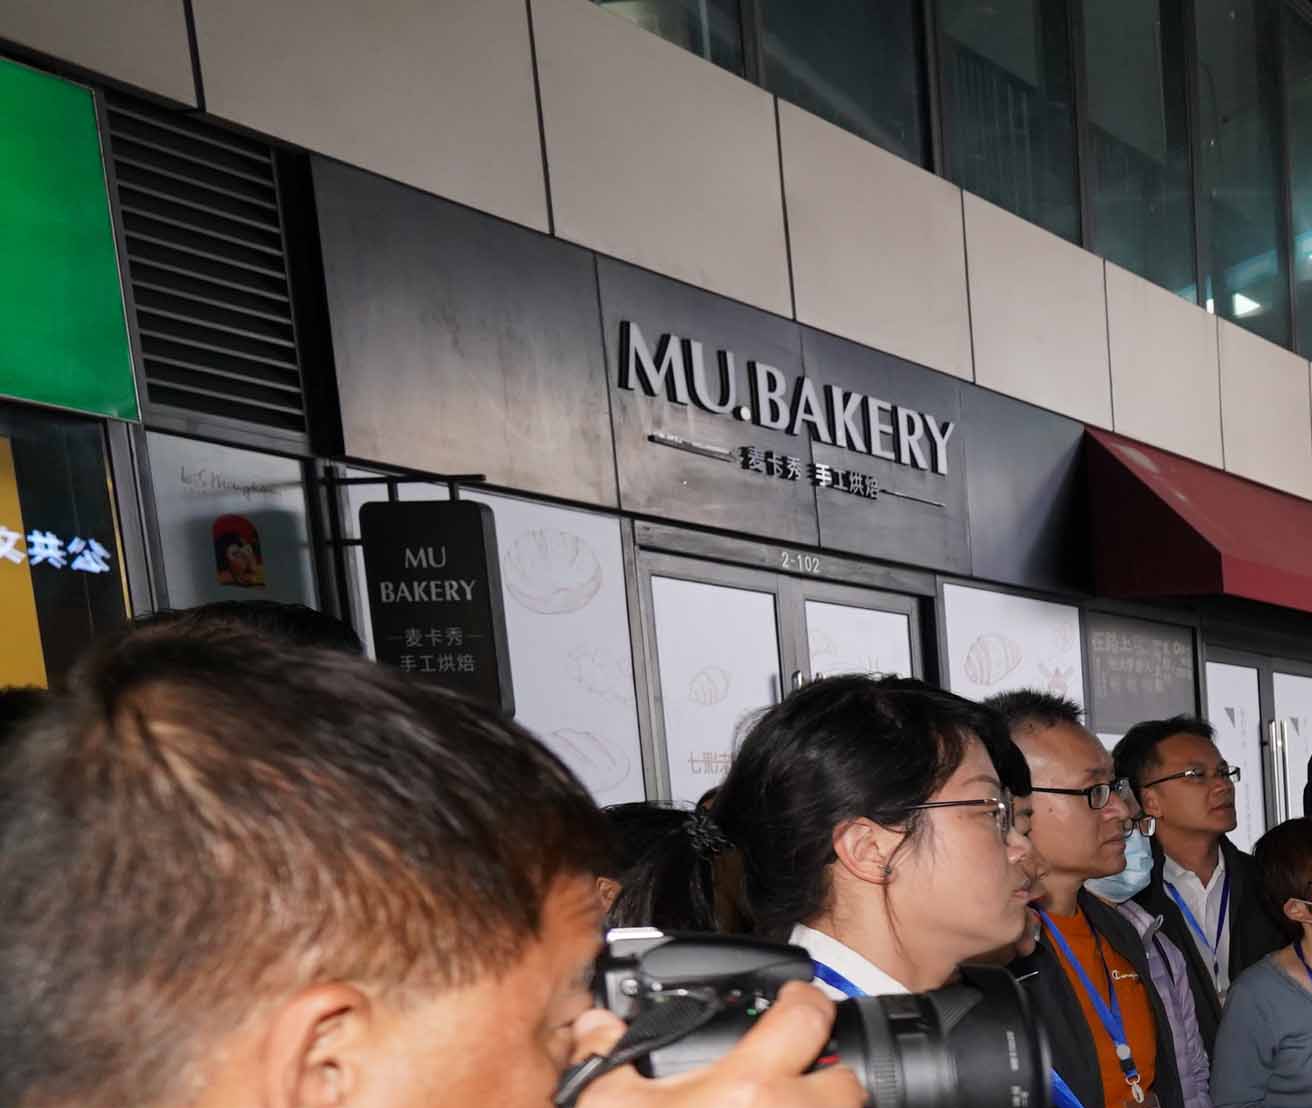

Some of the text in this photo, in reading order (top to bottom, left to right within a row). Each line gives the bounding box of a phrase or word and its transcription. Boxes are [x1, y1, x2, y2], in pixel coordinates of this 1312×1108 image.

[620, 321, 955, 476] MU.BAKERY
[404, 545, 446, 568] MU
[781, 551, 821, 573] 2-102
[379, 580, 476, 603] BAKERY
[404, 626, 464, 647] 麦卡秀
[400, 653, 476, 673] 手工烘焙
